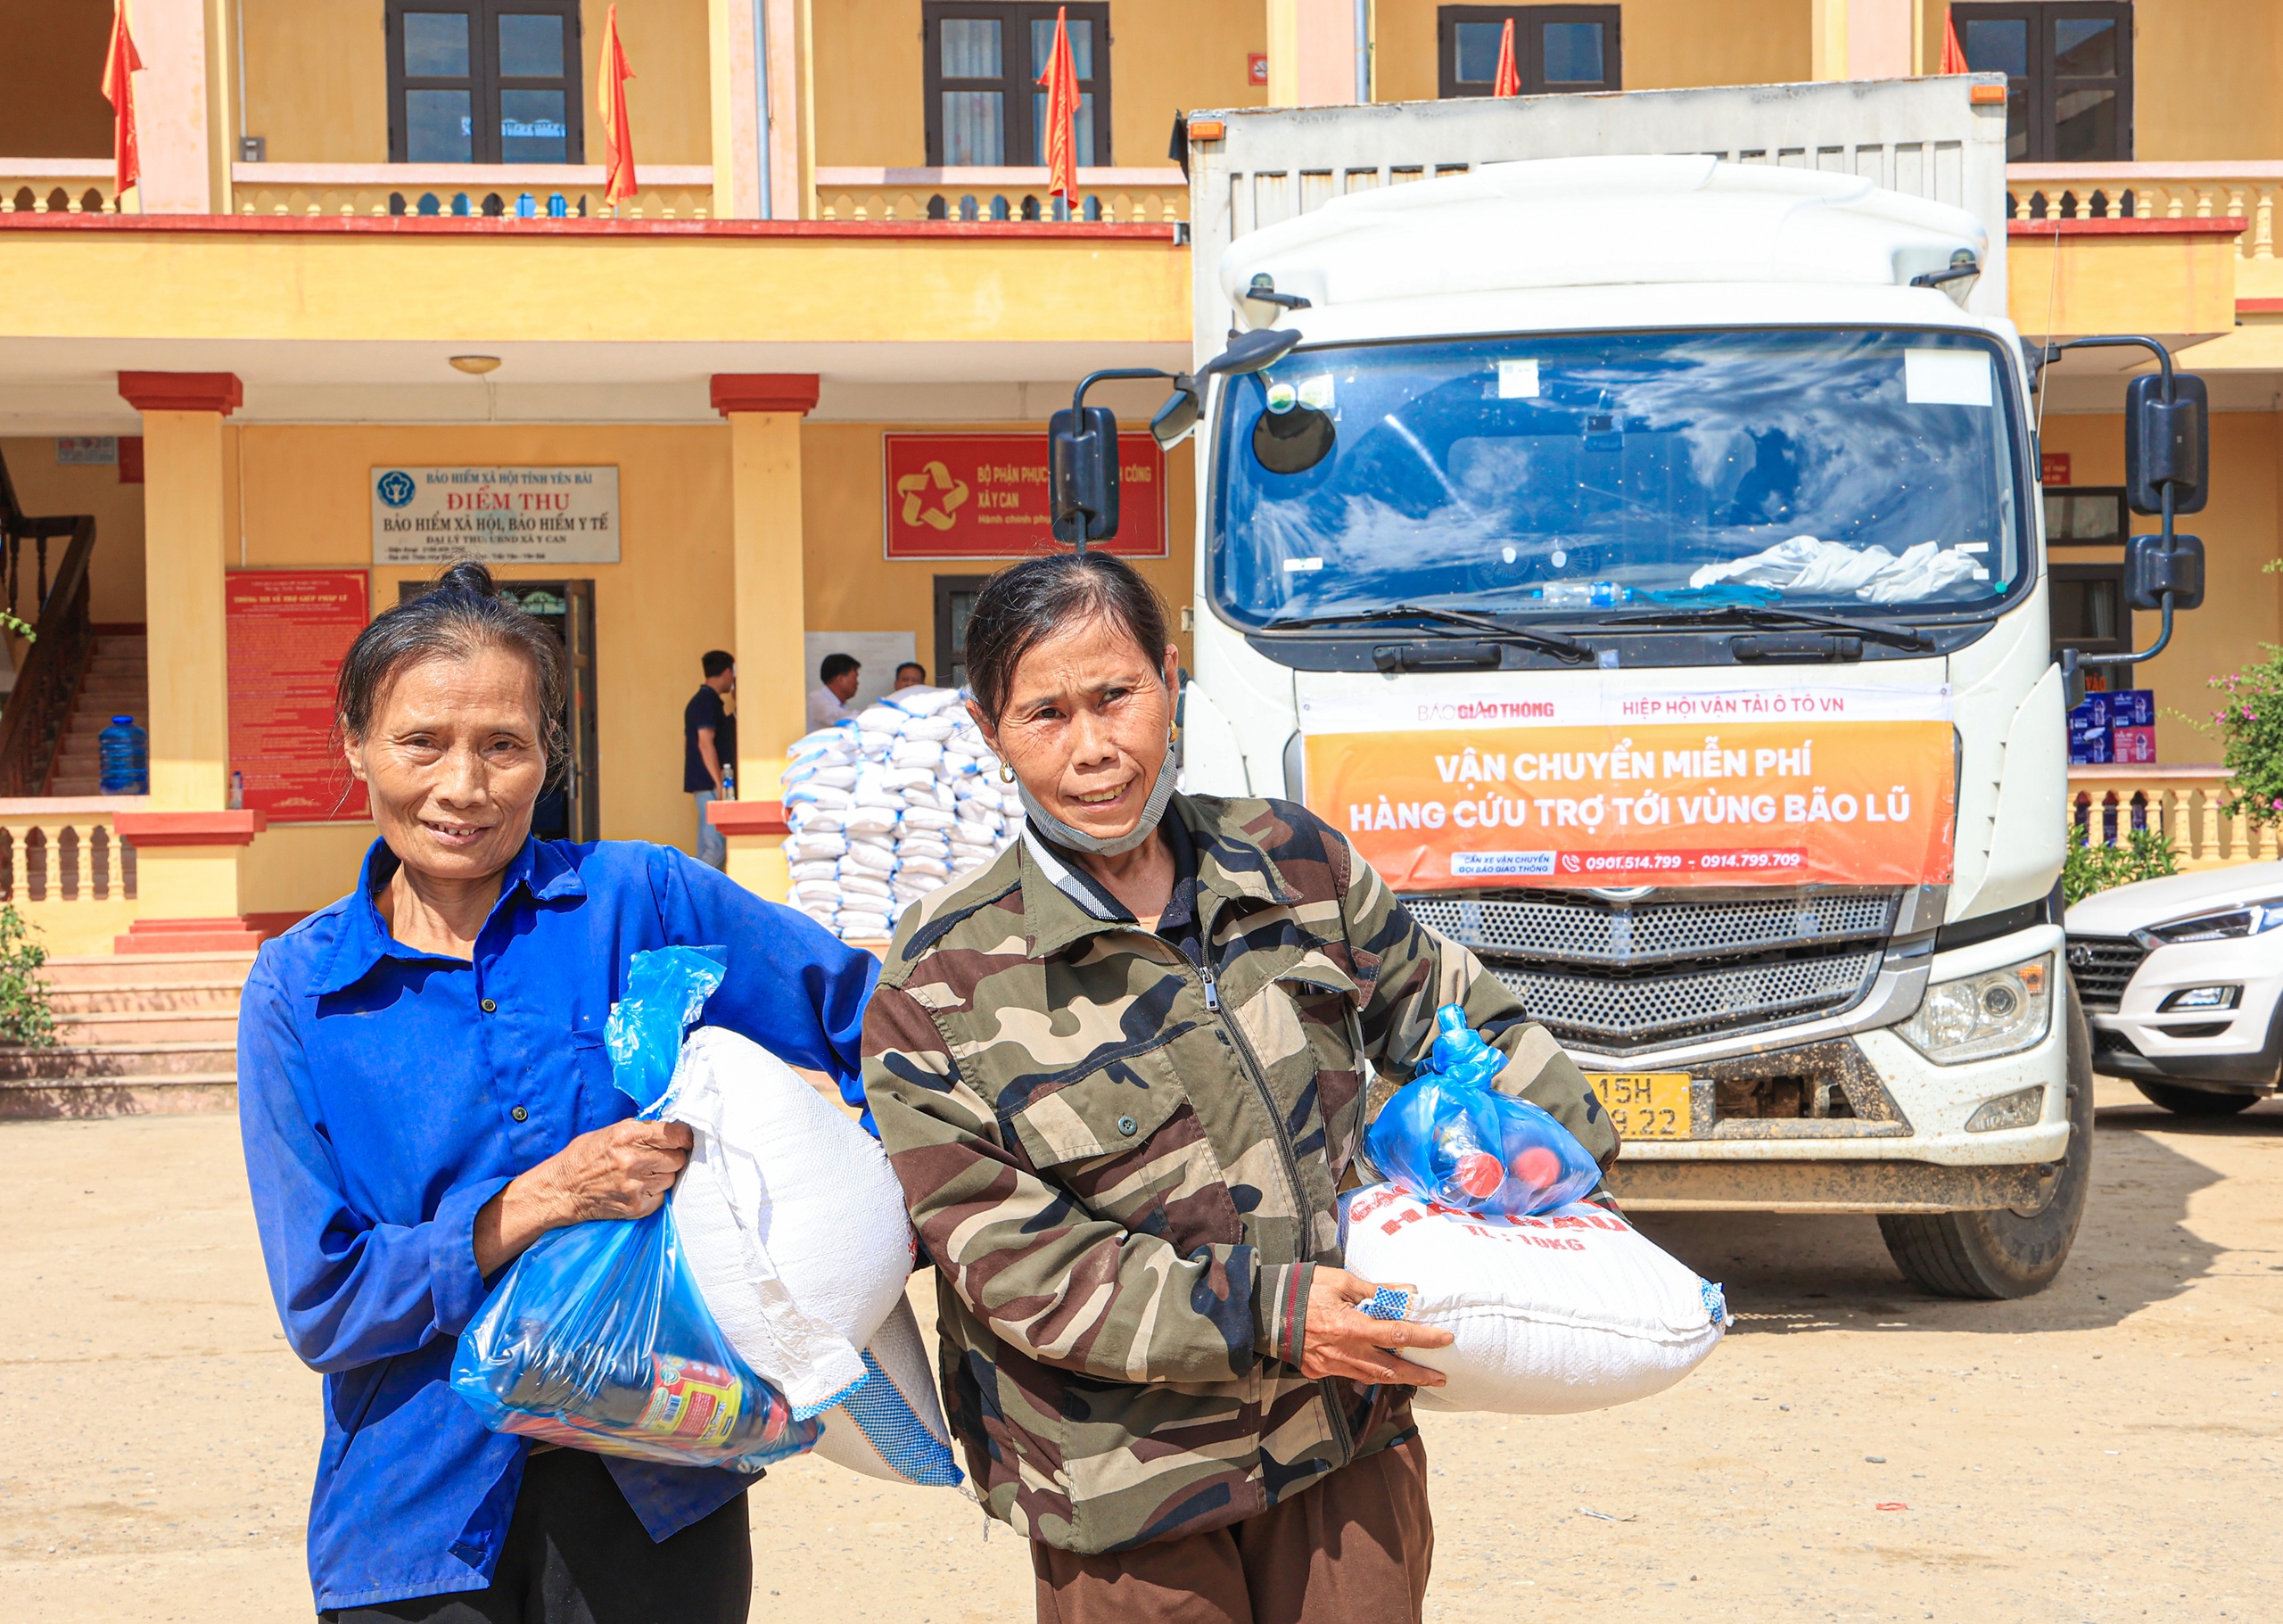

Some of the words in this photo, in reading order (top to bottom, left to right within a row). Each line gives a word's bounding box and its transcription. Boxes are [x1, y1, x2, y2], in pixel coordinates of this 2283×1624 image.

[977, 463, 992, 487] BỘ
[993, 463, 1019, 487] PHẬN
[447, 484, 511, 511] ĐIỂM
[518, 492, 571, 511] THU
[383, 513, 411, 532] BẢO
[416, 510, 451, 532] HIỂM
[455, 514, 473, 532] XÃ
[508, 512, 536, 532] BẢO
[540, 512, 575, 532] HIỂM
[578, 516, 588, 532] Y
[590, 511, 609, 531] TẾ
[1499, 701, 1554, 719] THÔNG
[1623, 697, 1661, 720] HIỆP
[1666, 696, 1696, 719] HỘI
[1701, 696, 1736, 718] VẬN
[1742, 693, 1768, 713] TẢI
[1773, 694, 1786, 713] Ô
[1792, 694, 1816, 713] TÔ
[1820, 697, 1845, 713] VN
[1435, 746, 1507, 791] VẬN
[1512, 738, 1655, 782] CHUYỂN
[1662, 736, 1747, 778] MIỄN
[1755, 739, 1813, 777] PHÍ
[1349, 795, 1446, 831] HÀNG
[1453, 792, 1526, 828] CỨU
[1533, 793, 1604, 835] TRỢ
[1611, 788, 1670, 826] TỚI
[1677, 787, 1776, 825] VÙNG
[1784, 785, 1859, 823] BÃO
[1867, 785, 1911, 822] LŨ
[1496, 865, 1516, 873] GIAO
[1586, 855, 1681, 870] 0901.514.799
[1701, 853, 1801, 869] 0914.799.709
[1599, 1077, 1651, 1104] 15H
[1462, 1224, 1497, 1240] TL
[1516, 1233, 1587, 1251] 10KG
